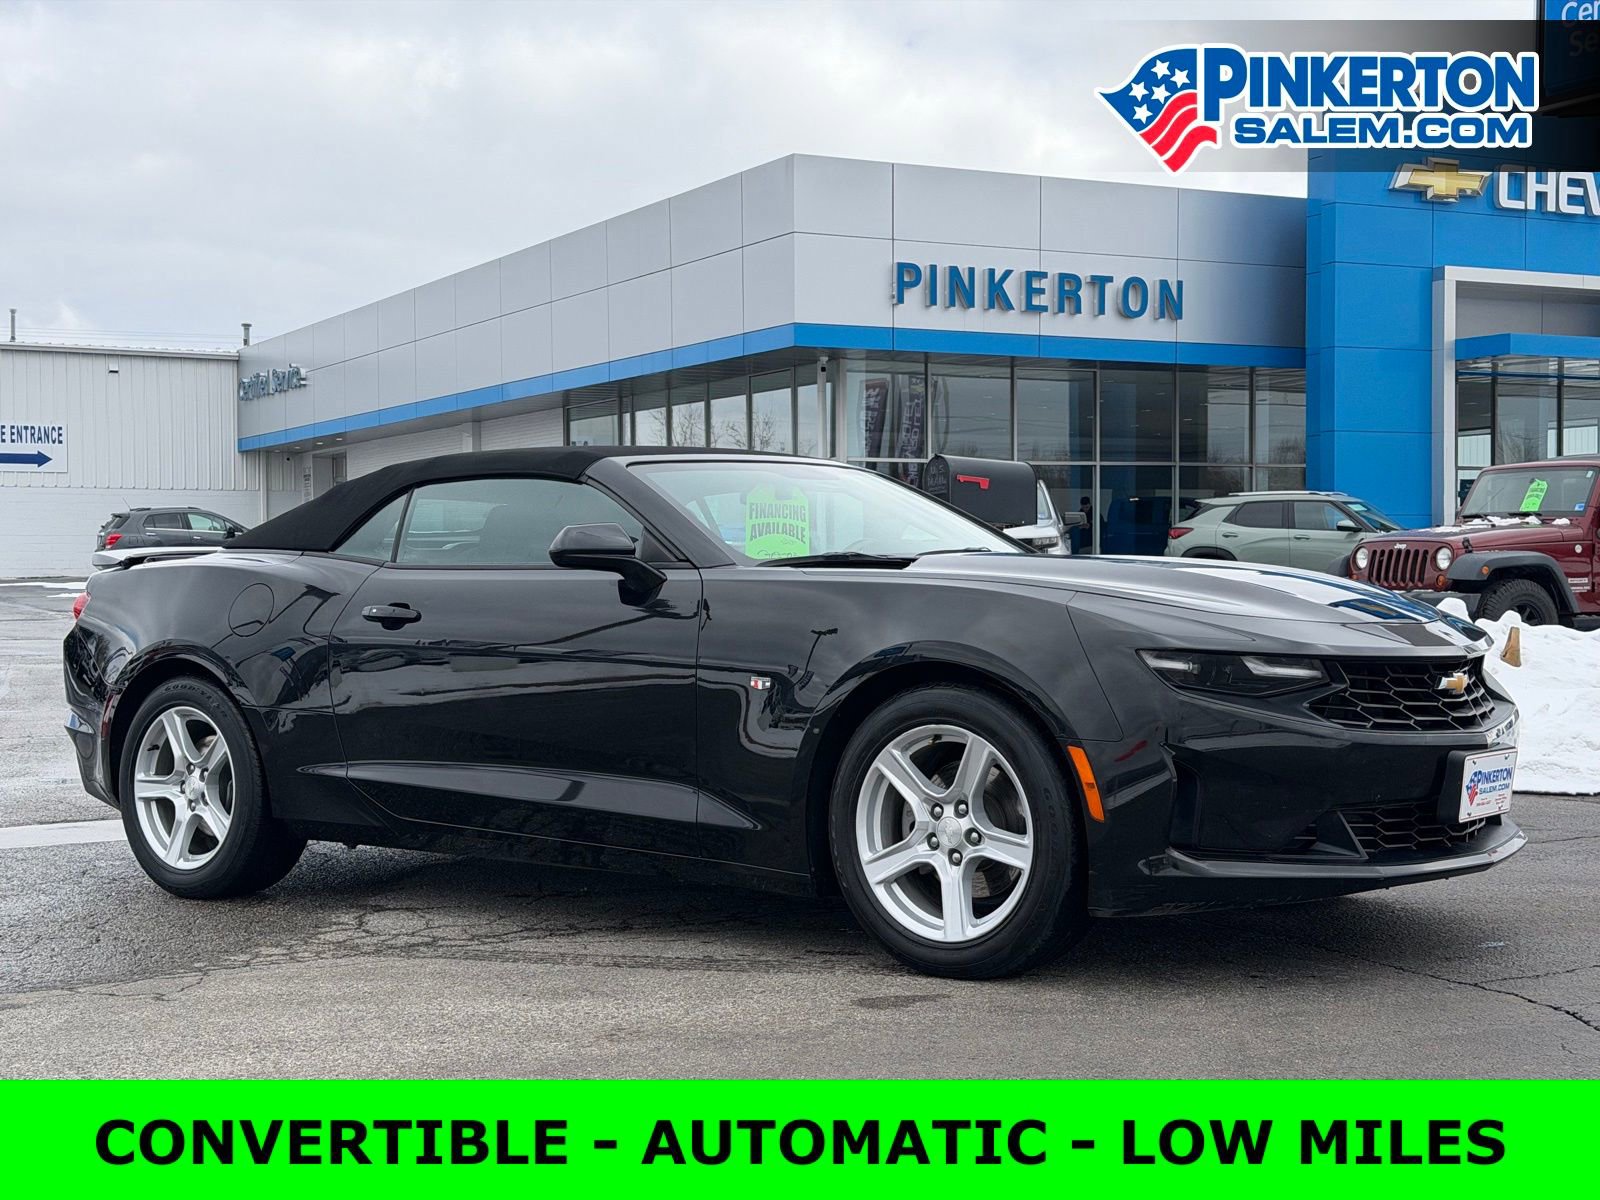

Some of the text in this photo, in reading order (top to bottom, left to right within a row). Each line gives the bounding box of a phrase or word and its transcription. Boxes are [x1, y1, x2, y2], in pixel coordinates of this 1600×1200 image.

[895, 262, 1184, 320] PINKERTON
[10, 425, 63, 444] ENTRANCE
[749, 503, 806, 522] FINANCING
[750, 522, 806, 545] AVAILABLE
[1477, 767, 1513, 789] PINKERTON
[1479, 783, 1510, 795] SALEM.COM
